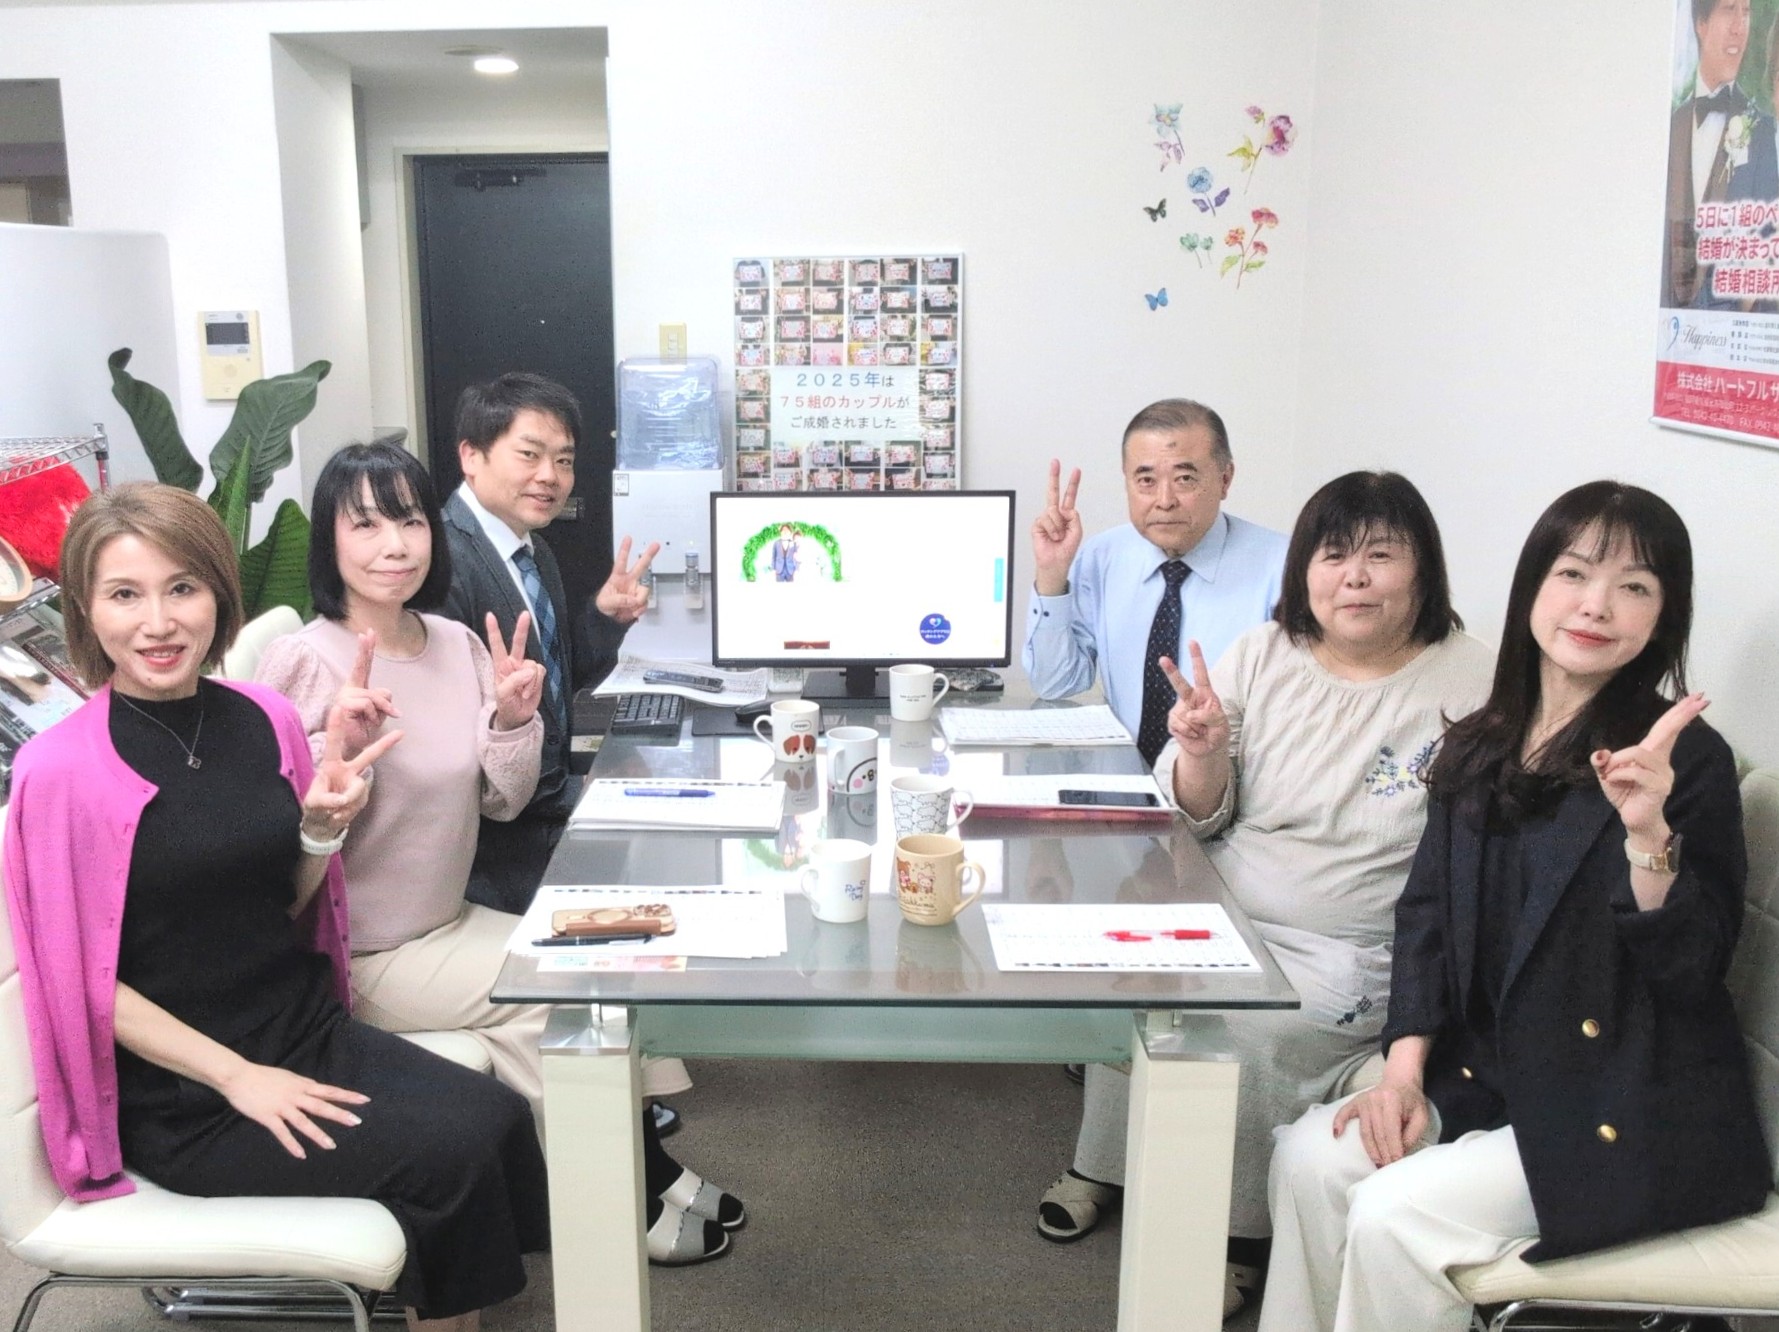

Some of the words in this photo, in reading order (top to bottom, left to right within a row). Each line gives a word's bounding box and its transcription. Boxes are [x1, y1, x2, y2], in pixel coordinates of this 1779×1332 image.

[1682, 324, 1727, 350] Happiness
[796, 371, 895, 388] 2025年は
[780, 394, 910, 409] 75組のカップルが
[791, 415, 897, 429] ご成婚されました
